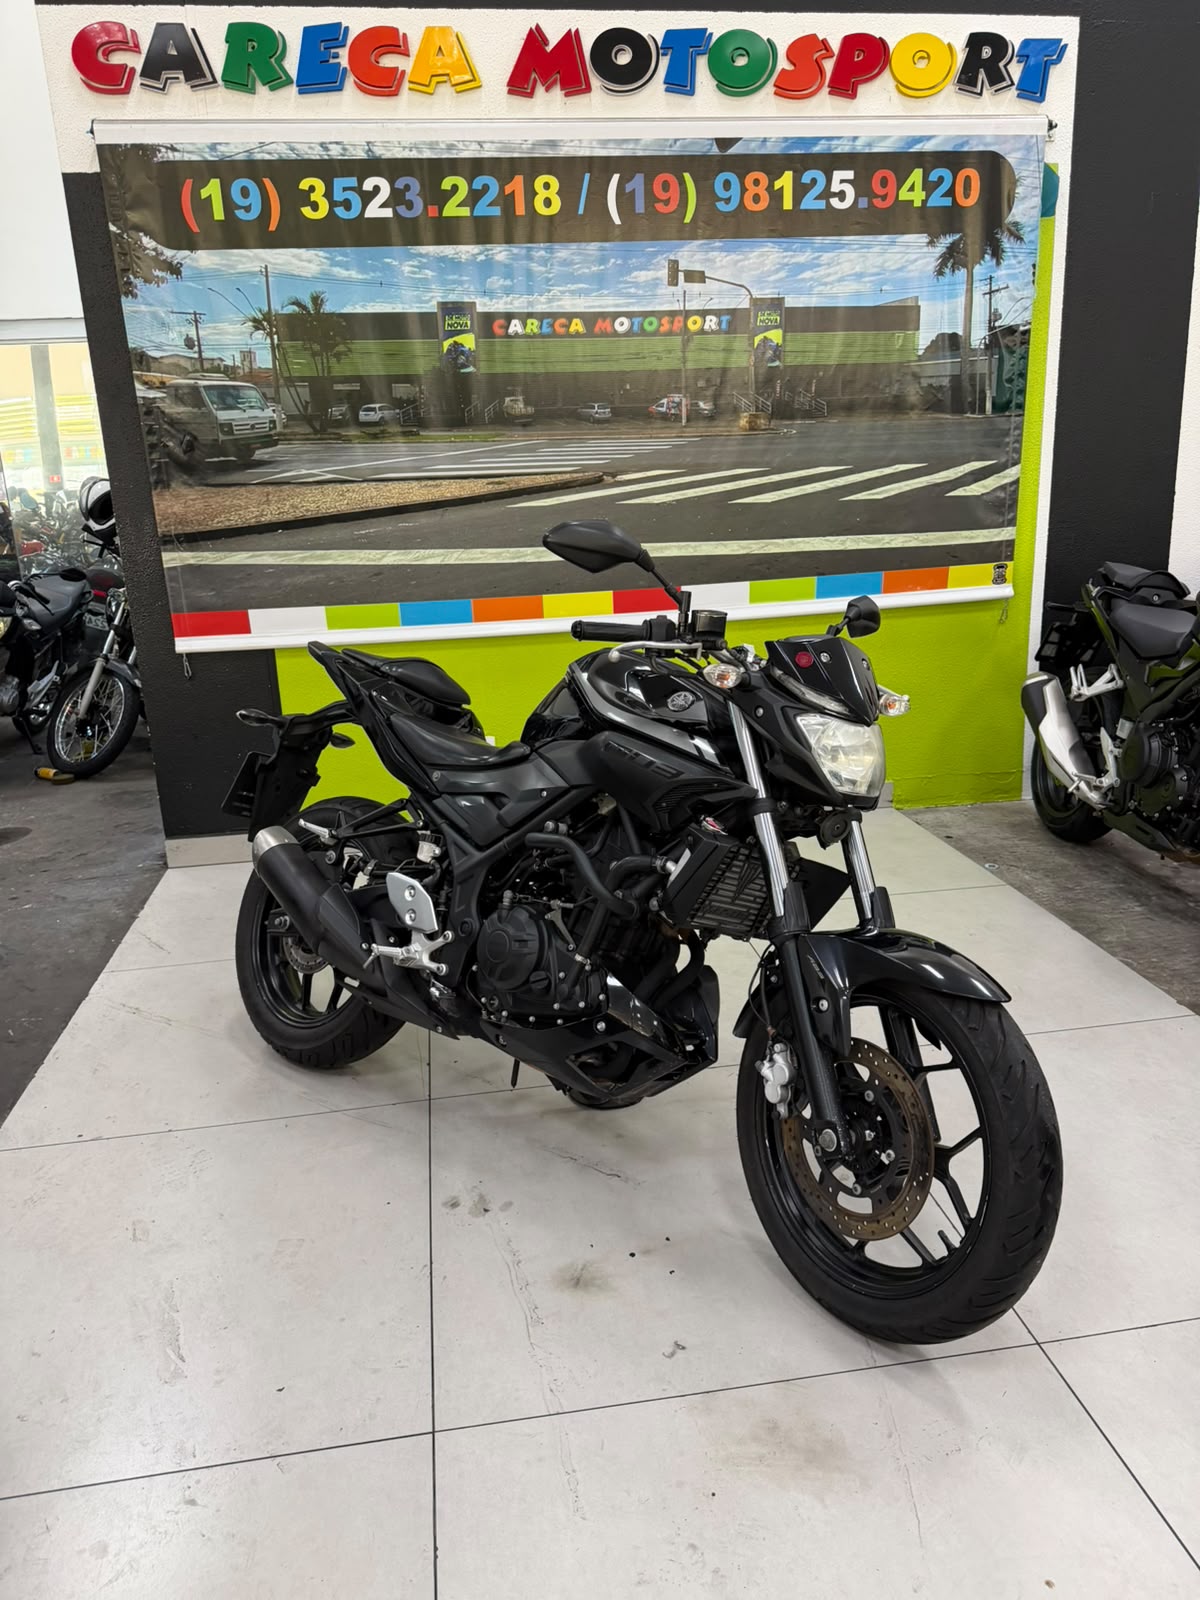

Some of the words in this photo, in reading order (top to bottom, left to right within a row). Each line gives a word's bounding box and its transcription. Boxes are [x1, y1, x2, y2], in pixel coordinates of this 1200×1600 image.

[71, 21, 483, 96] CARECA
[507, 23, 1067, 103] MOTOSPORT
[180, 177, 281, 233] (19)
[298, 174, 562, 221] 3523.2218
[607, 171, 697, 226] (19)
[714, 167, 981, 213] 98125.9420
[446, 321, 469, 329] NOVA
[492, 317, 586, 336] CARECA
[594, 314, 732, 334] MOTOSPORT
